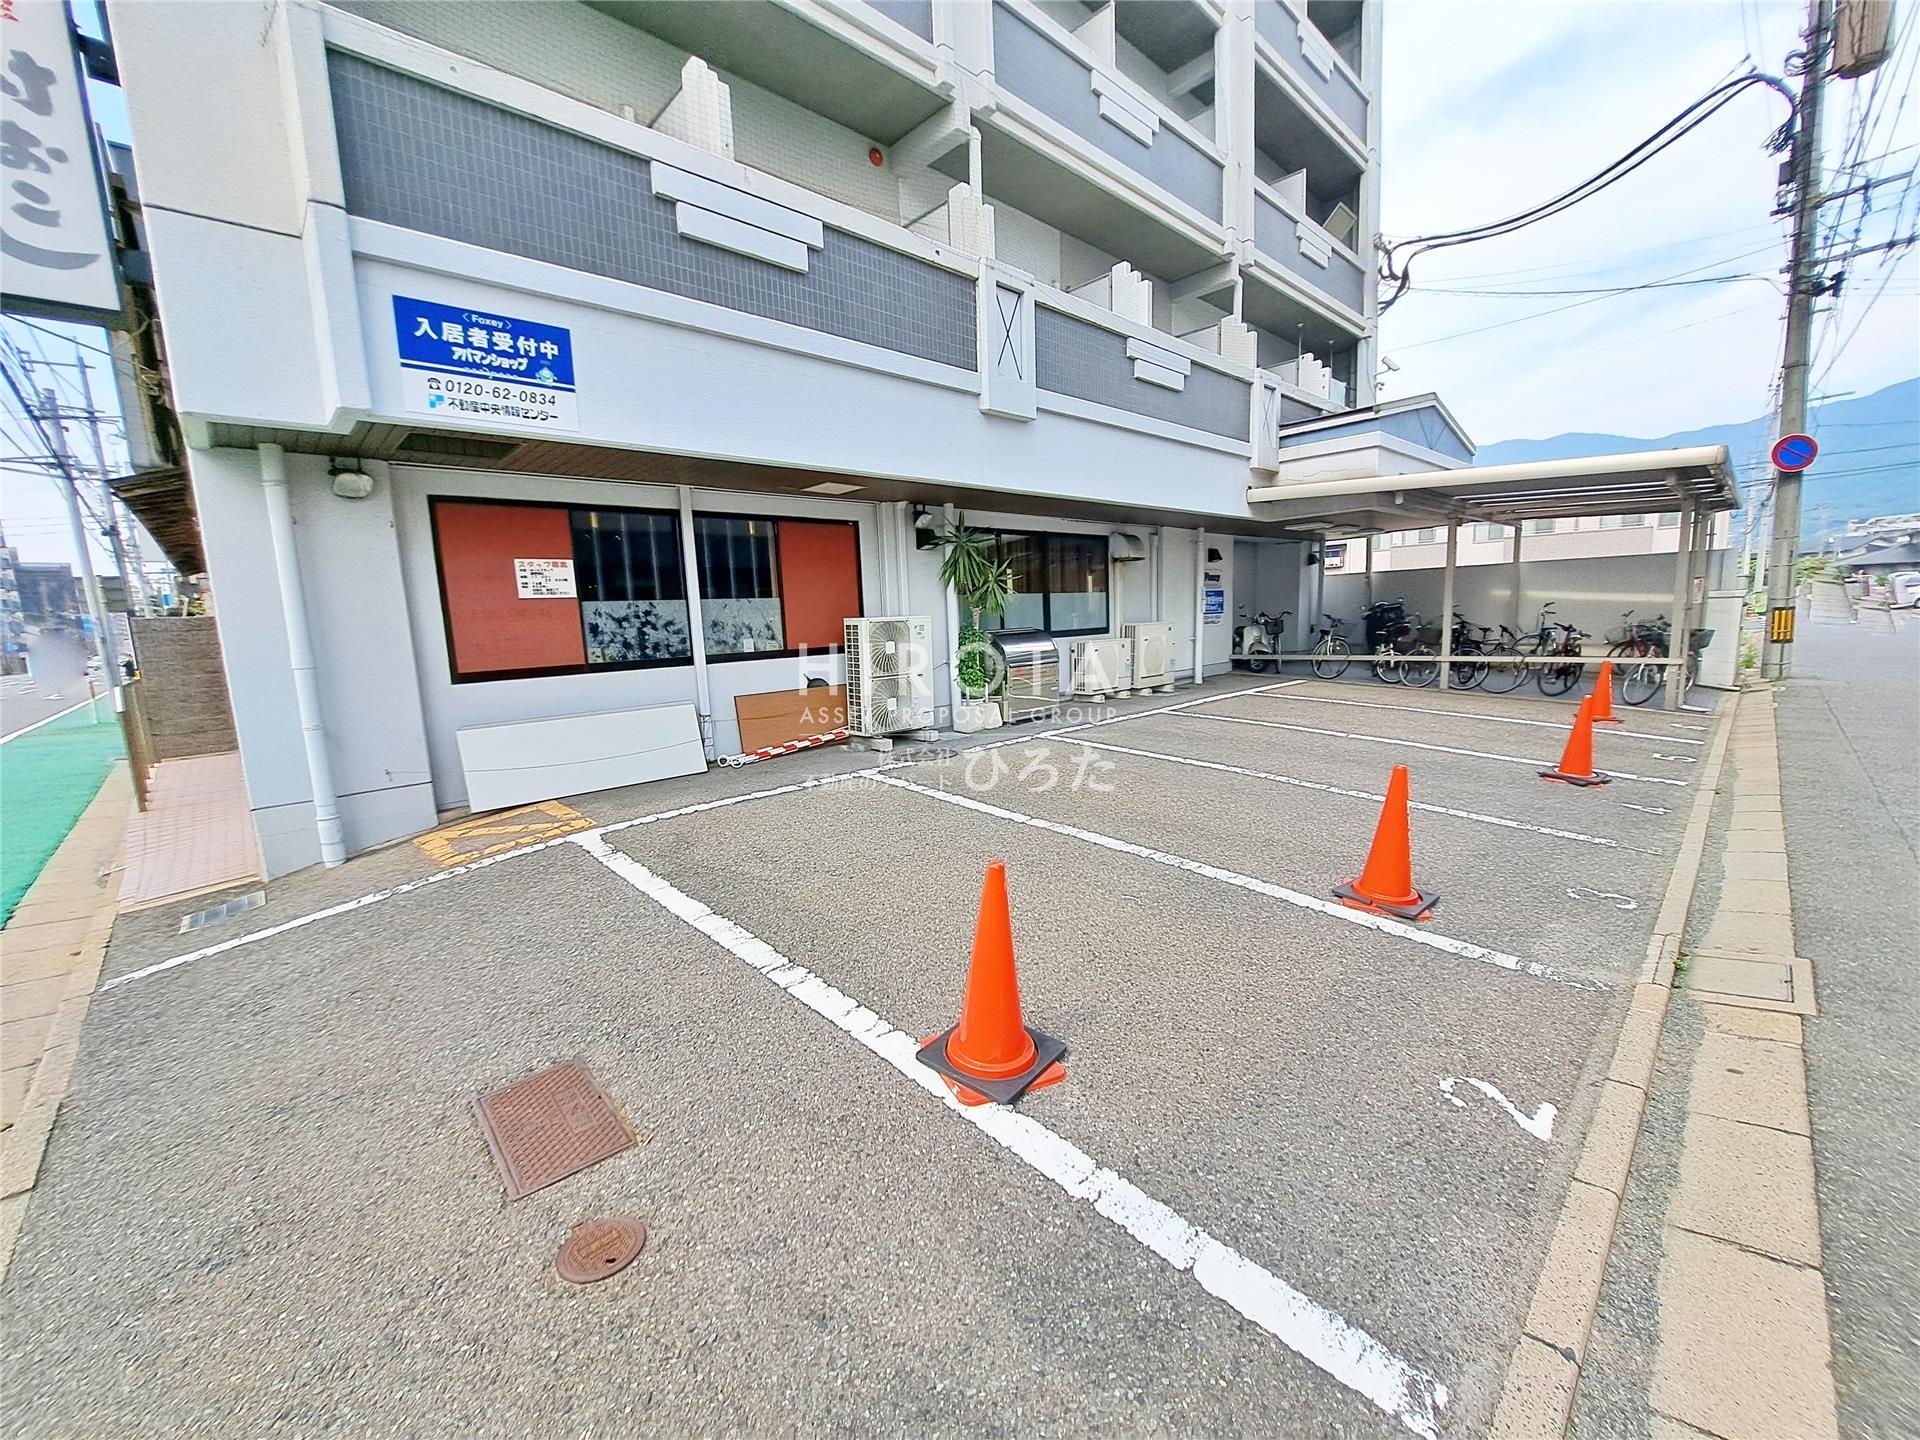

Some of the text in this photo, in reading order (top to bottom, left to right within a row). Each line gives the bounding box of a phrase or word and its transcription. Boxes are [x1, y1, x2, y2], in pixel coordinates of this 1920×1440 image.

[414, 317, 559, 360] 入居者受付中
[451, 346, 528, 371] アパマンショップ
[445, 380, 556, 406] 0120-62-0834
[448, 397, 559, 421] 不動産中央情報センター
[1438, 1075, 1559, 1142] 2
